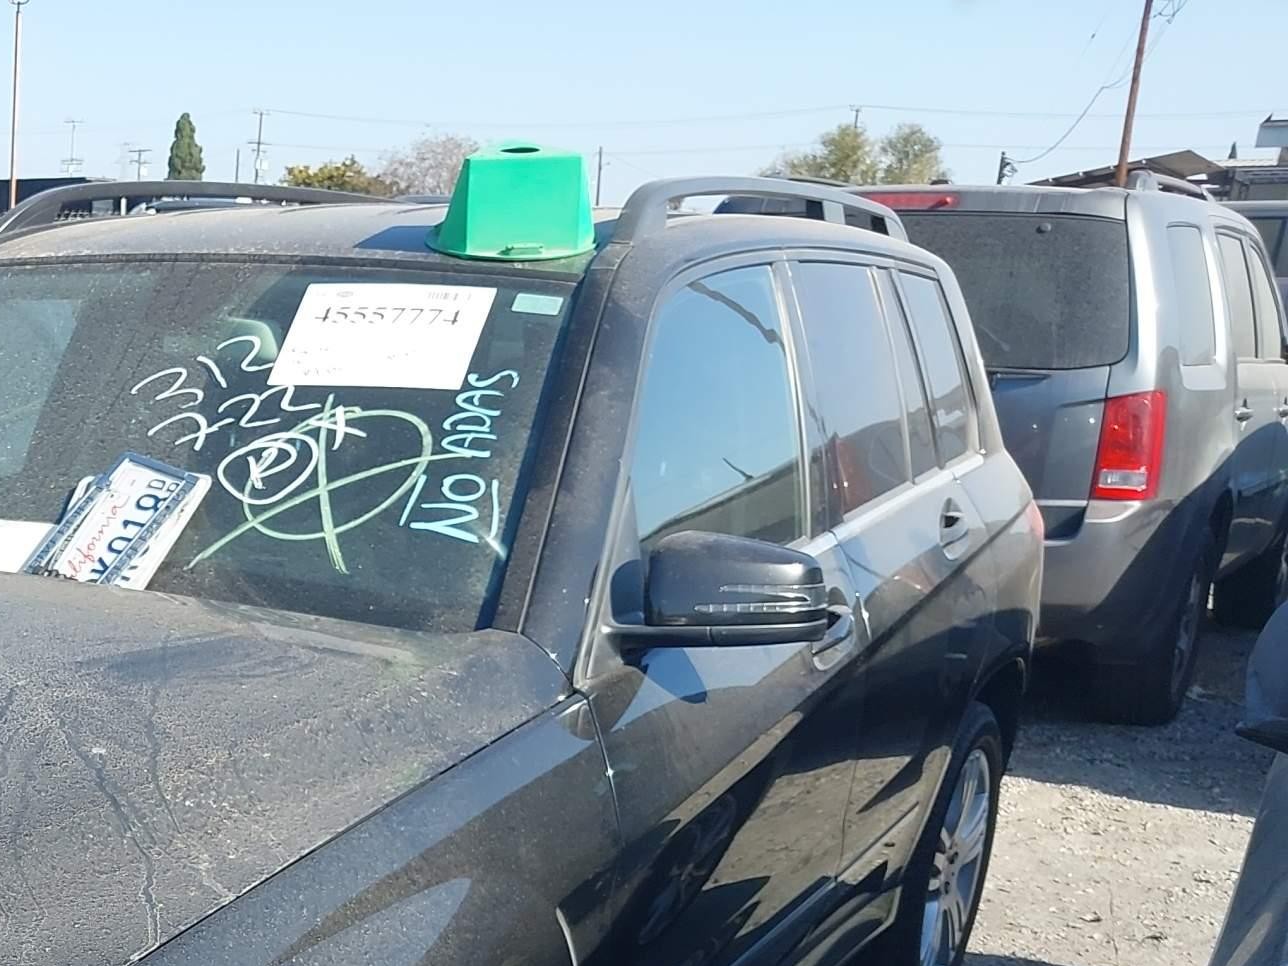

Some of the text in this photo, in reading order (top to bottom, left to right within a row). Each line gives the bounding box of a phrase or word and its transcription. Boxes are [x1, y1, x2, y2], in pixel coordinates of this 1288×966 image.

[409, 370, 520, 543] NO ADAS
[68, 493, 131, 579] lifornia
